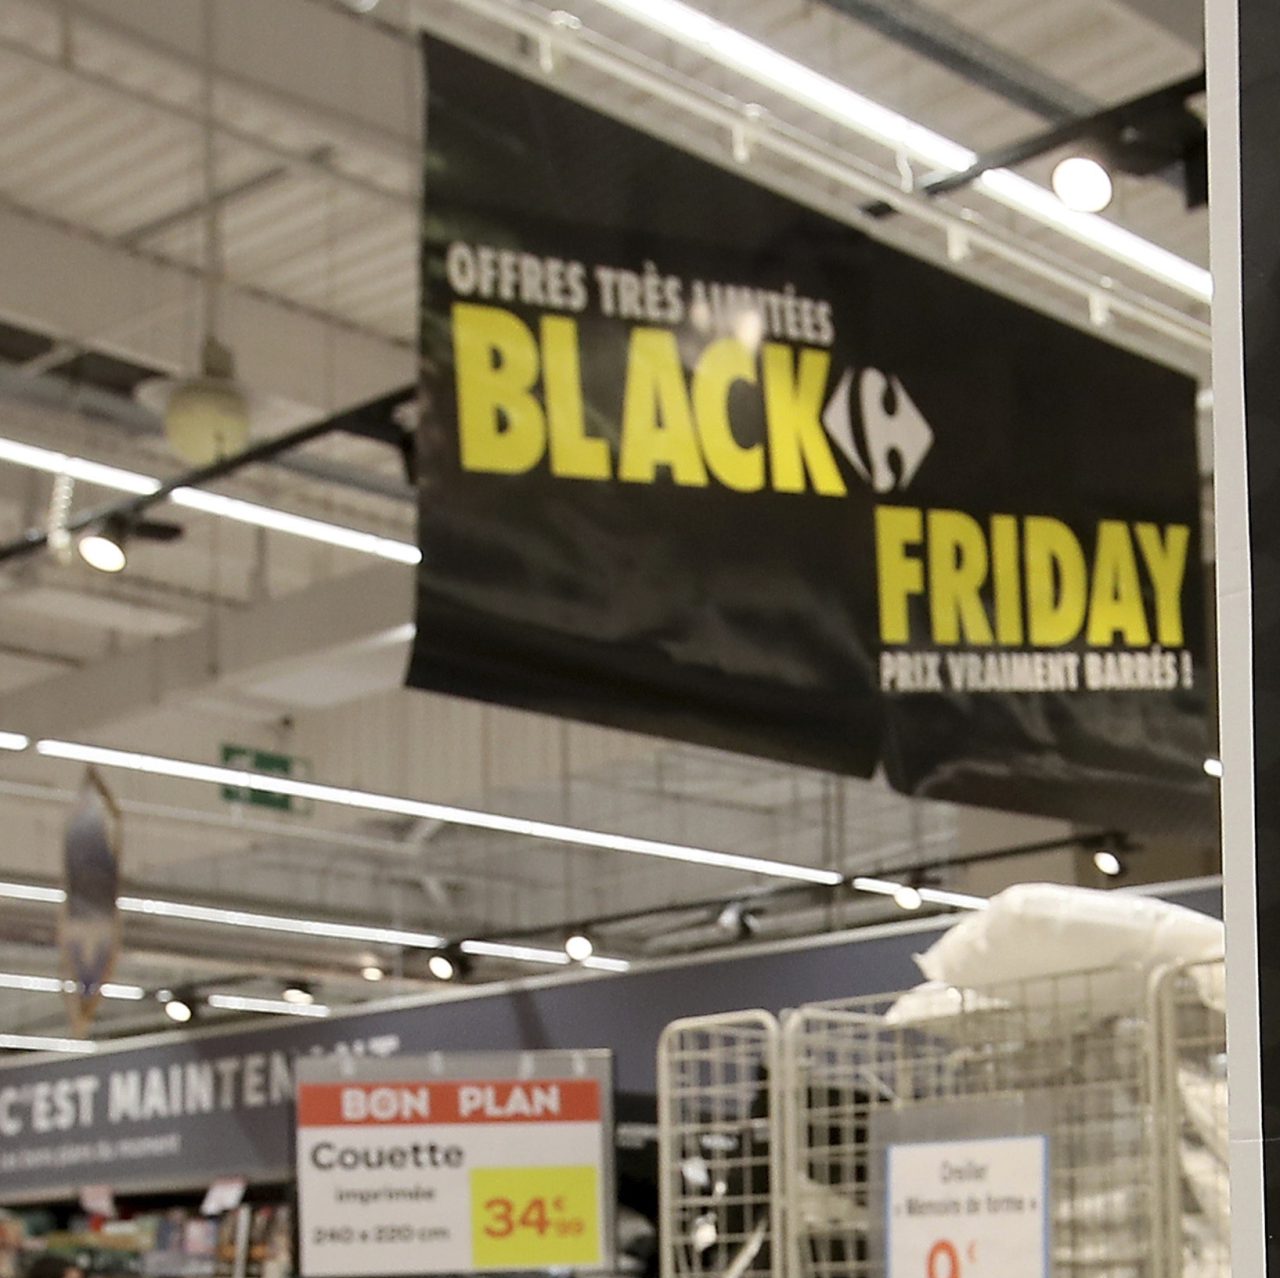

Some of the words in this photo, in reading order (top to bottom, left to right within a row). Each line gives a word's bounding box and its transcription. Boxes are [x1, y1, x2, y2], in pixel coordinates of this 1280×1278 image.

[445, 241, 588, 311] OFFRES
[596, 258, 682, 322] TRÈS
[451, 302, 847, 497] BLACK
[875, 505, 1189, 647] FRIDAY
[880, 651, 943, 692] PRIX
[946, 651, 1080, 692] VRAIMENT
[1083, 643, 1179, 691] BARRÉS
[342, 1088, 430, 1120] BON
[458, 1086, 561, 1117] PLAN
[311, 1142, 463, 1170] Couette
